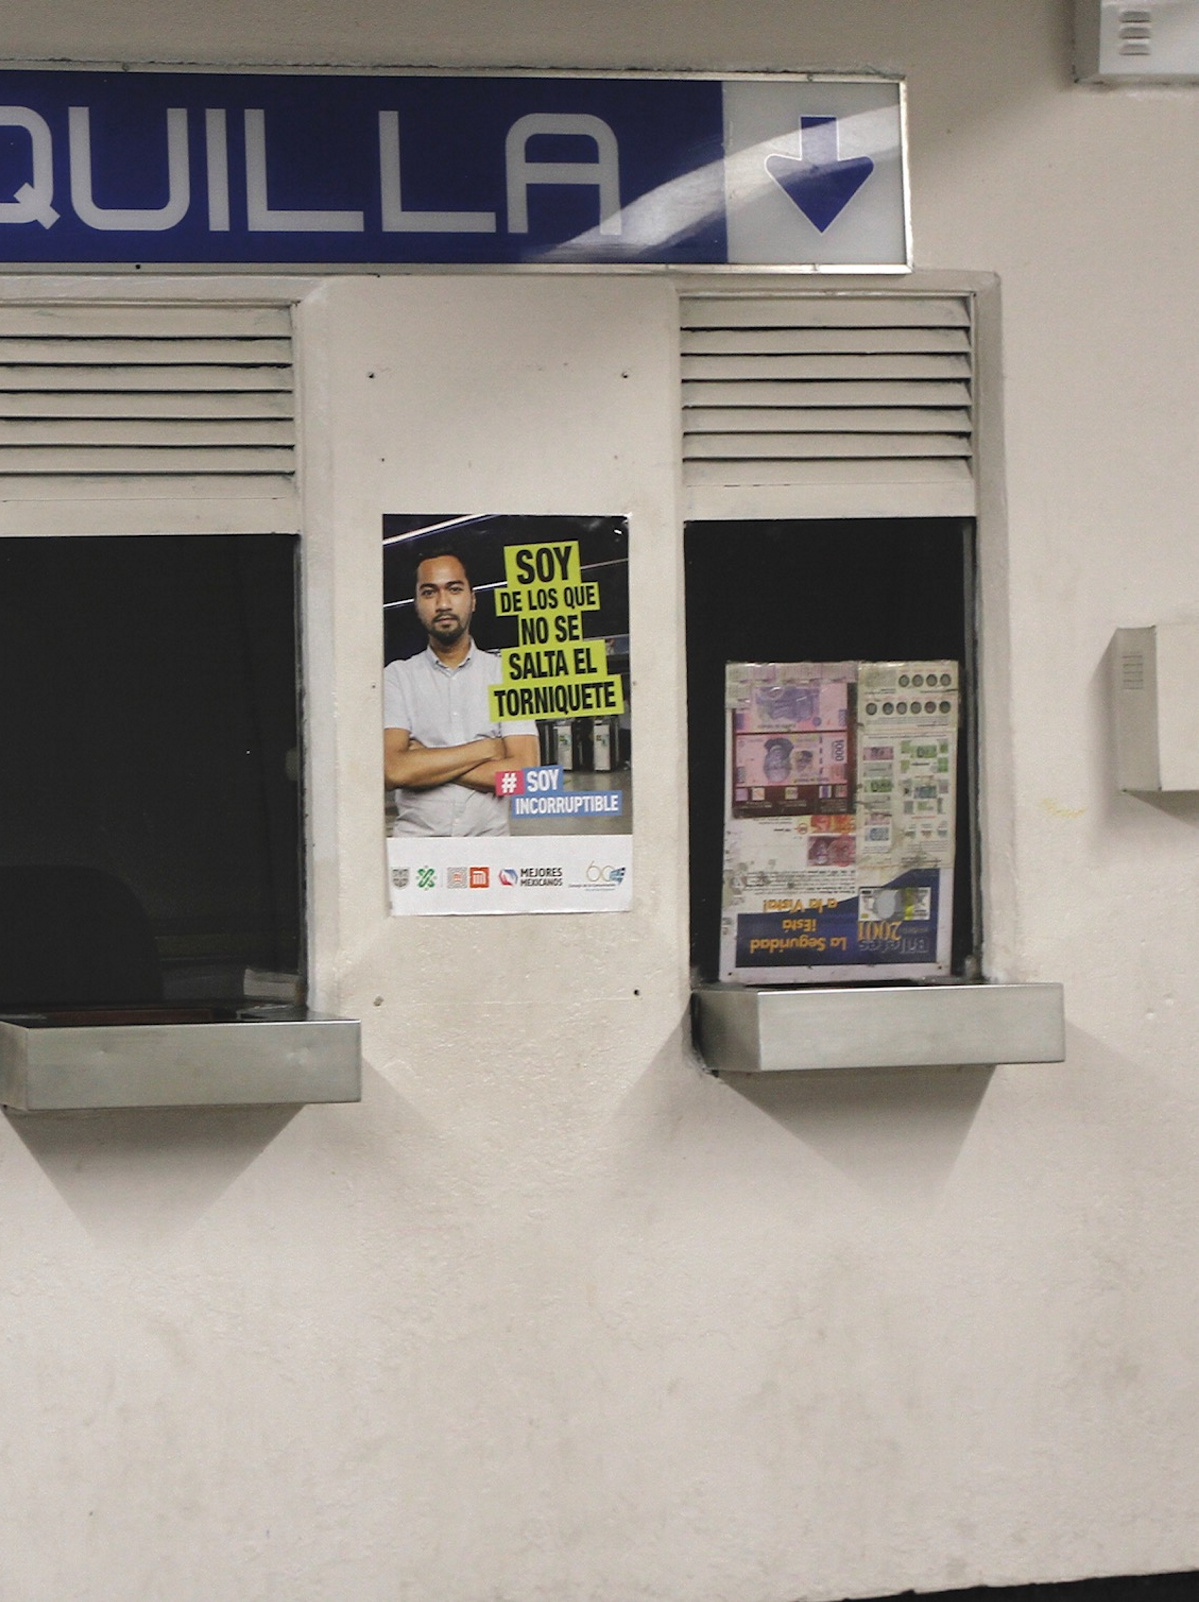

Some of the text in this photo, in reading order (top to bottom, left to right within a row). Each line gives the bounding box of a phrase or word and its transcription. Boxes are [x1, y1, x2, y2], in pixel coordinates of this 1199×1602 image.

[515, 545, 572, 584] SOY
[500, 585, 596, 612] DE LOS QUE
[520, 614, 580, 644] NO SE
[508, 647, 597, 680] SALTA EL
[494, 681, 616, 716] TORNIQUETE
[515, 795, 619, 815] INCORRUPTIBLE
[519, 866, 562, 877] MEJORES
[519, 877, 563, 887] MEXICANOS
[762, 898, 838, 913] a la Vista!
[856, 920, 902, 941] 2001
[749, 935, 847, 953] La Seguridad
